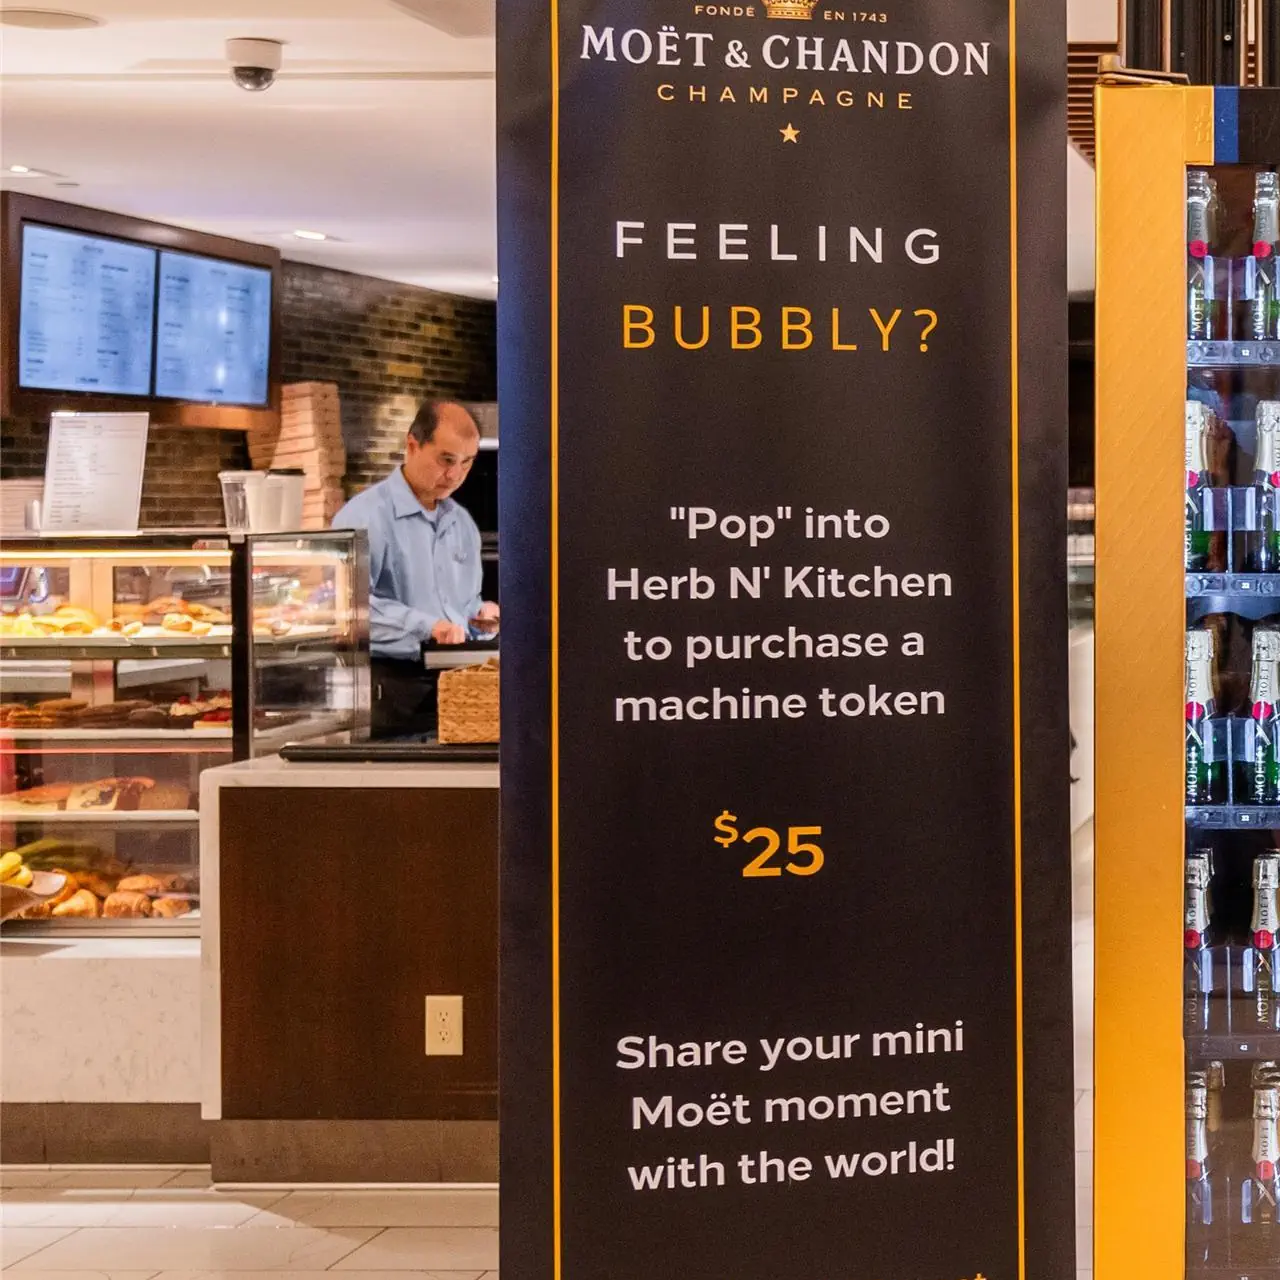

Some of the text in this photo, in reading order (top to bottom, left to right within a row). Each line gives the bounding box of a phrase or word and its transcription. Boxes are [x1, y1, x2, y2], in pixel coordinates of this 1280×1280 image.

[823, 10, 845, 21] EN
[852, 12, 887, 23] 1743
[580, 24, 990, 76] MOËT & CHANDON
[657, 84, 913, 109] CHAMPAGNE
[616, 220, 940, 265] FEELING
[623, 304, 938, 353] BUBBLY?
[670, 506, 890, 547] "Pop" into
[607, 565, 952, 601] Herb N' Kitchen
[623, 626, 924, 668] to purchase a
[615, 684, 945, 722] machine token
[713, 810, 825, 877] $25
[616, 1019, 964, 1072] Share your mini
[632, 1082, 951, 1130] Moët moment
[627, 1138, 955, 1191] with the world!
